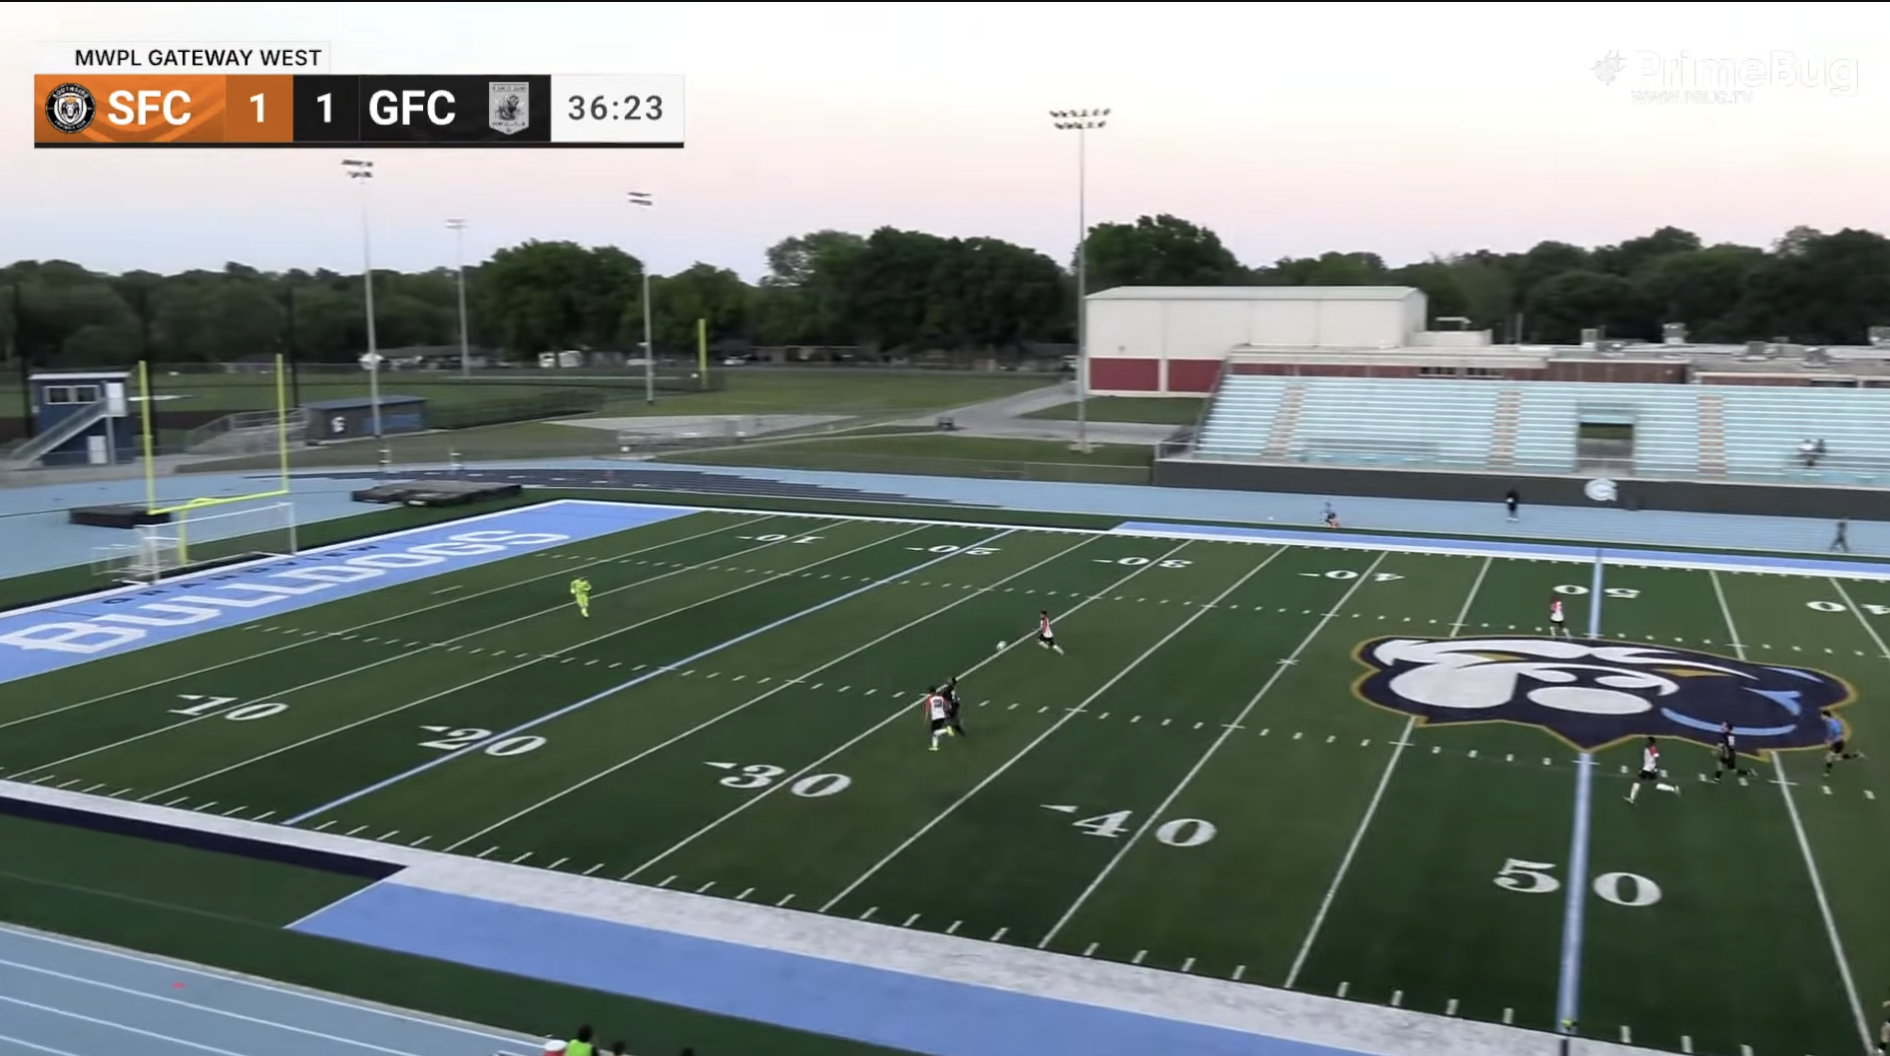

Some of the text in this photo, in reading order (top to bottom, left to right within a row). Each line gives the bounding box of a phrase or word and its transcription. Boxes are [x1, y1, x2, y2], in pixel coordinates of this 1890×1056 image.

[0, 530, 571, 654] BULLDOGS
[170, 695, 288, 722] 10
[419, 728, 547, 757] 20
[719, 764, 852, 798] 30
[1073, 810, 1217, 847] 40
[1493, 858, 1662, 907] 50
